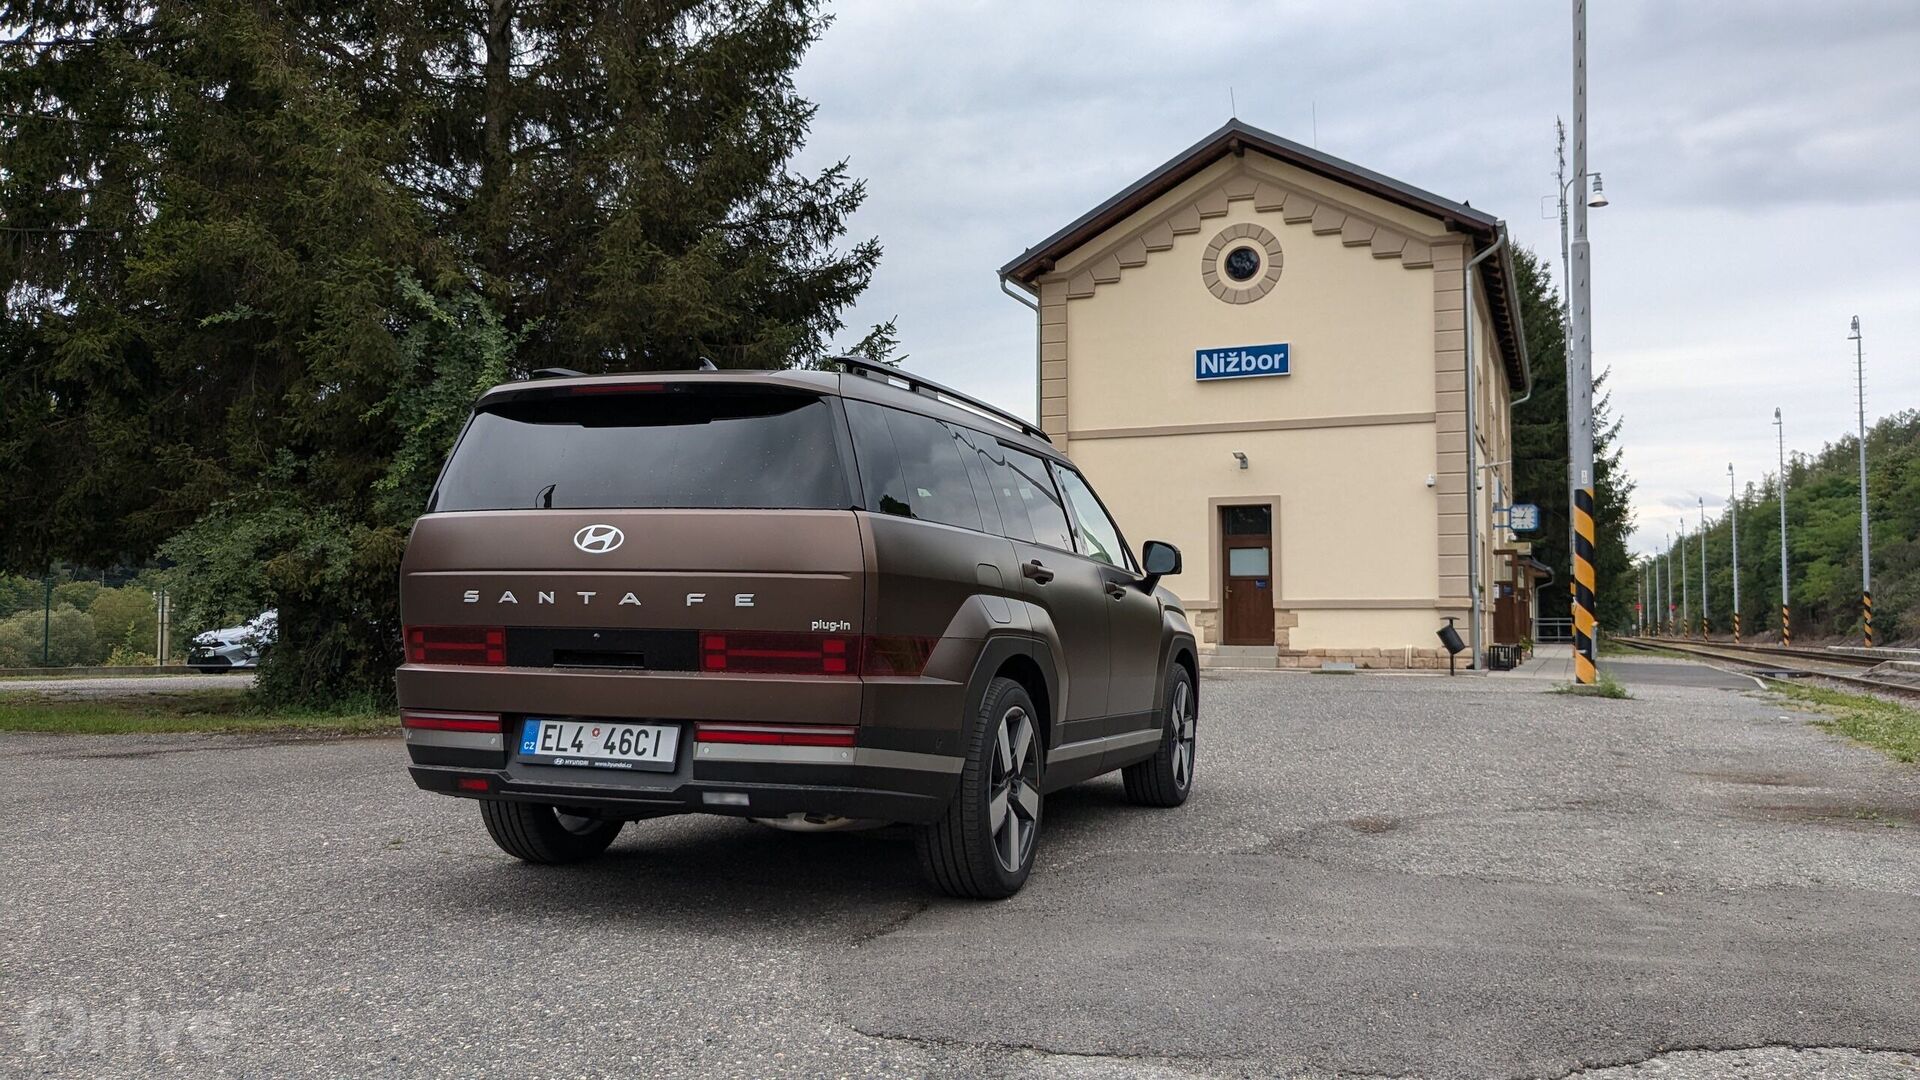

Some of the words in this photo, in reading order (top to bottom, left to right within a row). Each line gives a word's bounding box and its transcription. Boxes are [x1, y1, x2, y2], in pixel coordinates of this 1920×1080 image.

[1200, 351, 1284, 374] Nižbor
[463, 589, 641, 606] SANTA
[686, 592, 755, 607] FE
[811, 619, 851, 632] plug-in
[523, 741, 536, 750] CZ
[541, 724, 584, 753] EL4
[603, 727, 662, 757] 46CI
